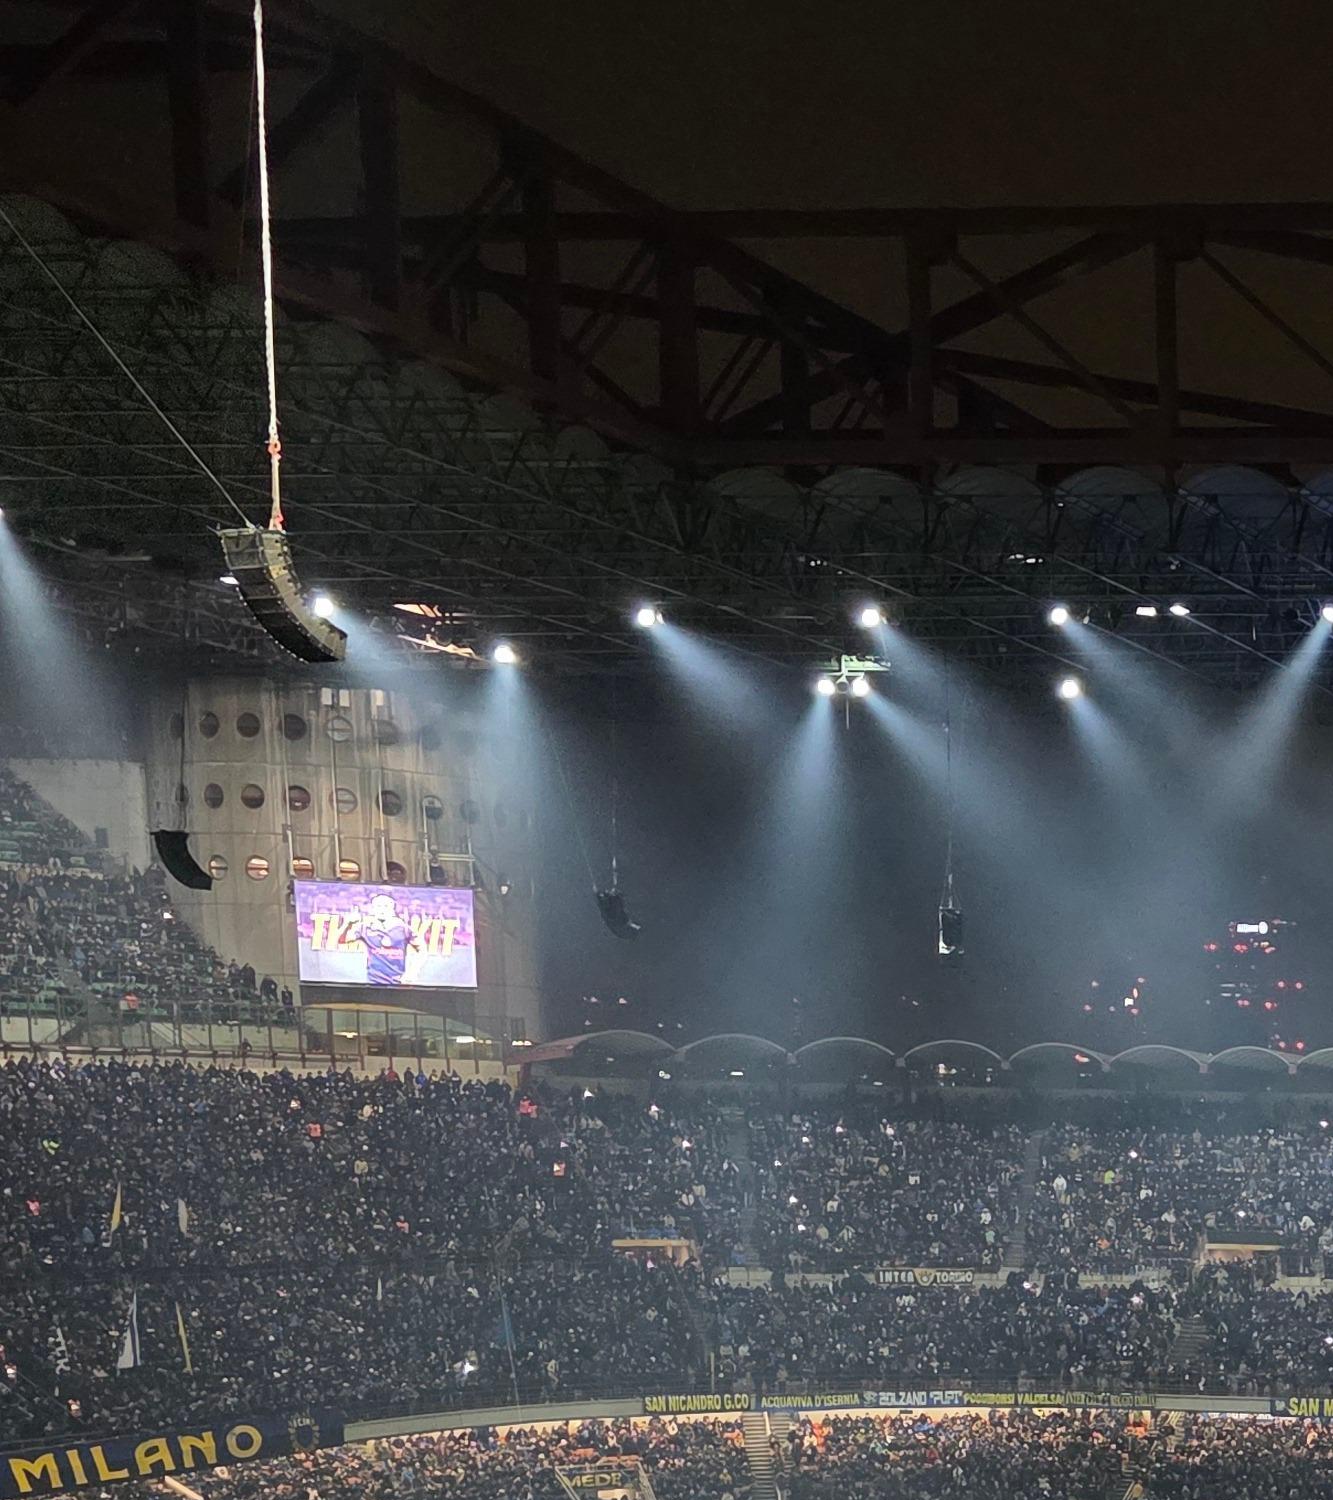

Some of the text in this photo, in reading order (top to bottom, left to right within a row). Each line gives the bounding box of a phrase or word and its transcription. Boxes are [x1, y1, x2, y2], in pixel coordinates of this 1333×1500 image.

[645, 1397, 669, 1412] SAN
[669, 1396, 722, 1411] NICANDRO
[761, 1394, 860, 1408] ACQUAVIVA D'ISERNIA
[878, 1391, 928, 1406] BOLZANO
[1288, 1396, 1319, 1416] SAN
[9, 1424, 262, 1492] MILANO
